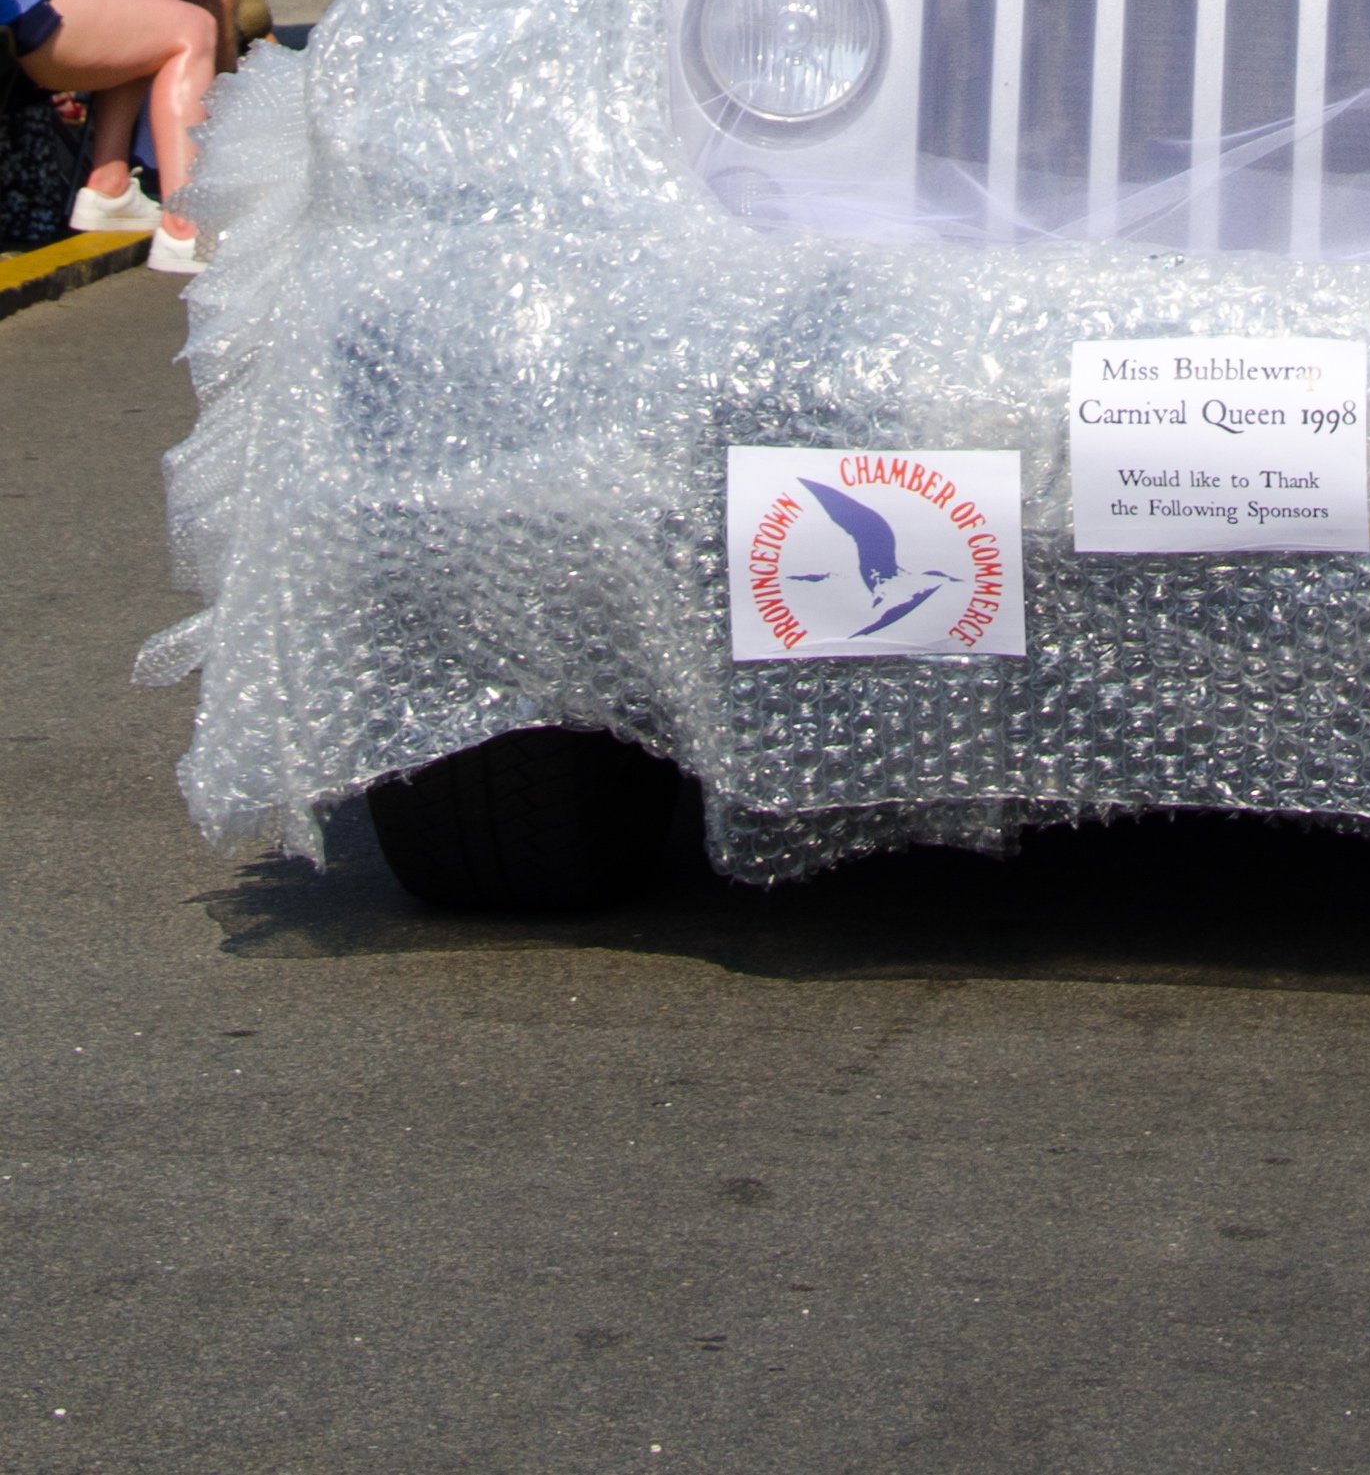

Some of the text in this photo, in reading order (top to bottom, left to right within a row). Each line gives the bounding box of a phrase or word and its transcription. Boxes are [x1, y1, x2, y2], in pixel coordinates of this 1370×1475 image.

[1102, 358, 1323, 392] Miss Bubblewrap
[1078, 399, 1357, 434] Carnival Queen 1998
[1118, 469, 1320, 489] Would like to Thank
[1110, 500, 1329, 524] the Following Sponsors
[749, 455, 1003, 650] PROVINCETOWN CHAMBER OF COMMERCE
